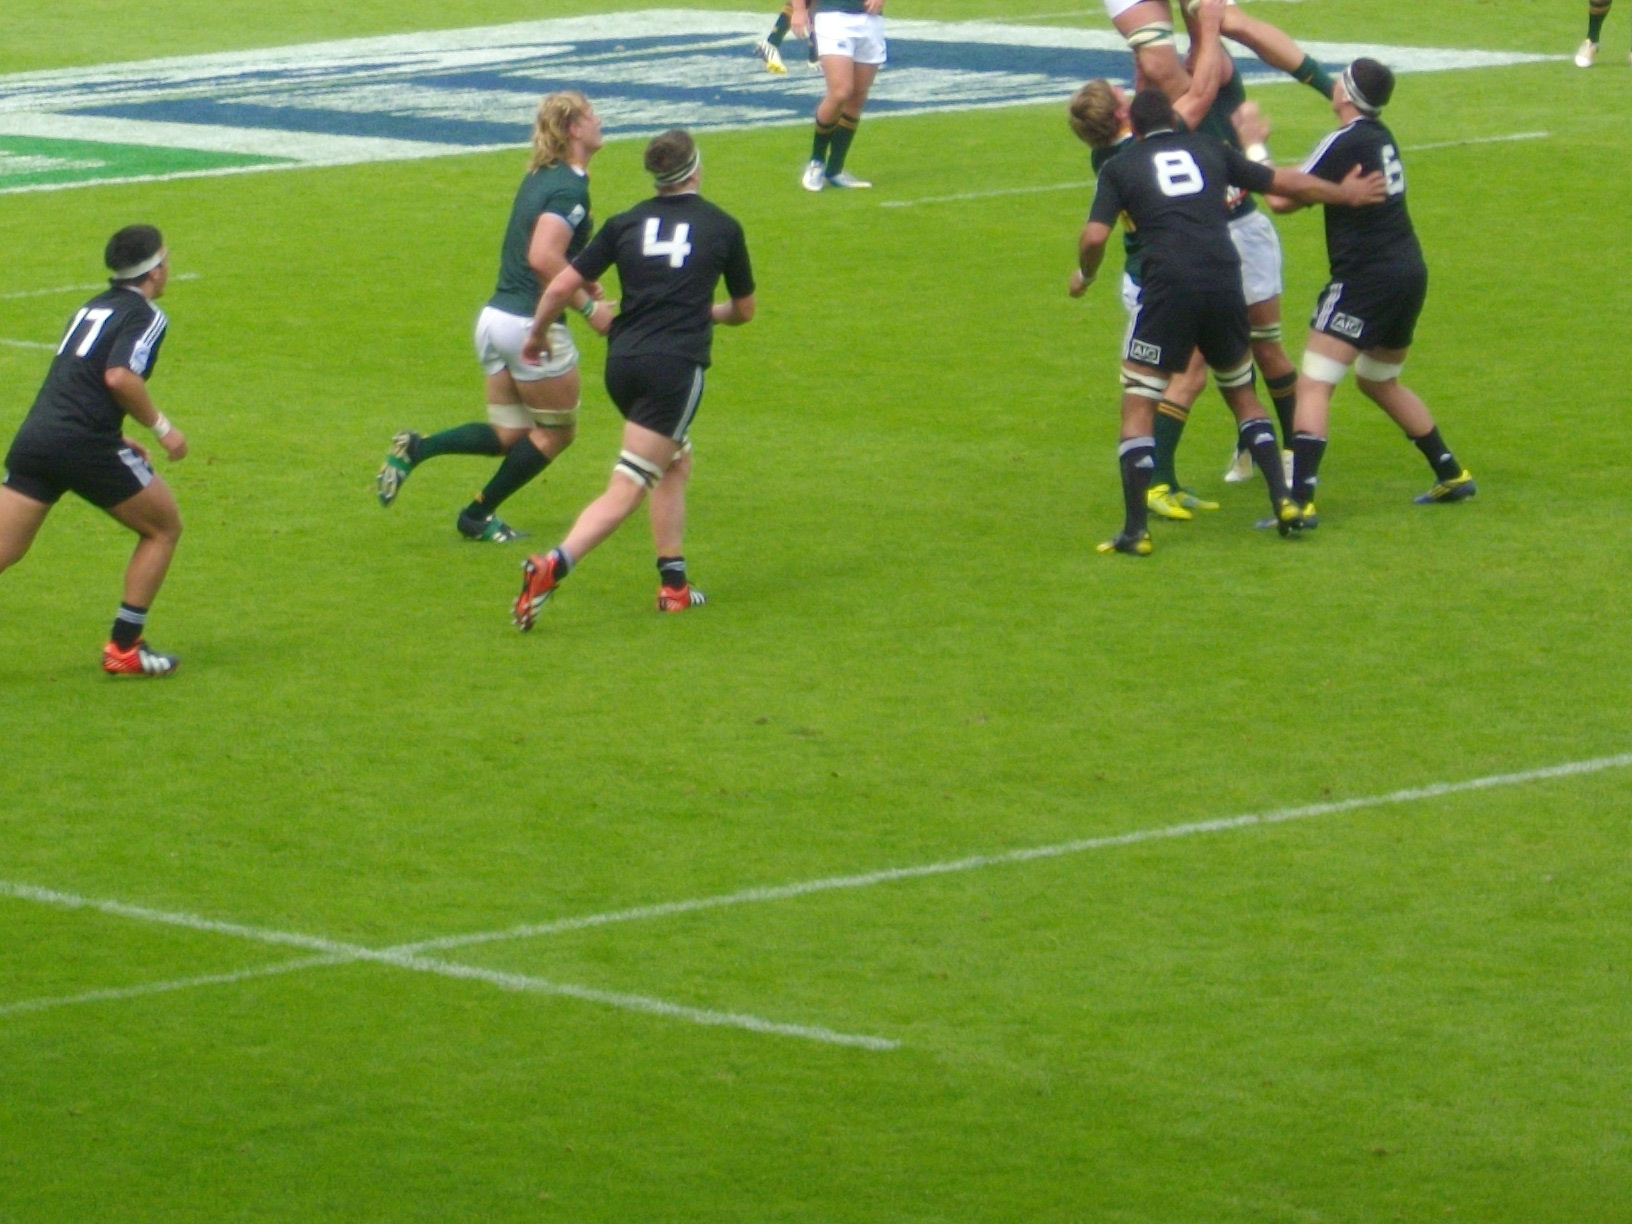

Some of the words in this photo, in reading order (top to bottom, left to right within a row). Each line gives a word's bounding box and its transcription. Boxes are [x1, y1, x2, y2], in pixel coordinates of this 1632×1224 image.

[1154, 149, 1205, 198] 8
[1381, 144, 1405, 196] 6
[642, 217, 692, 269] 4
[1132, 342, 1160, 362] AIG
